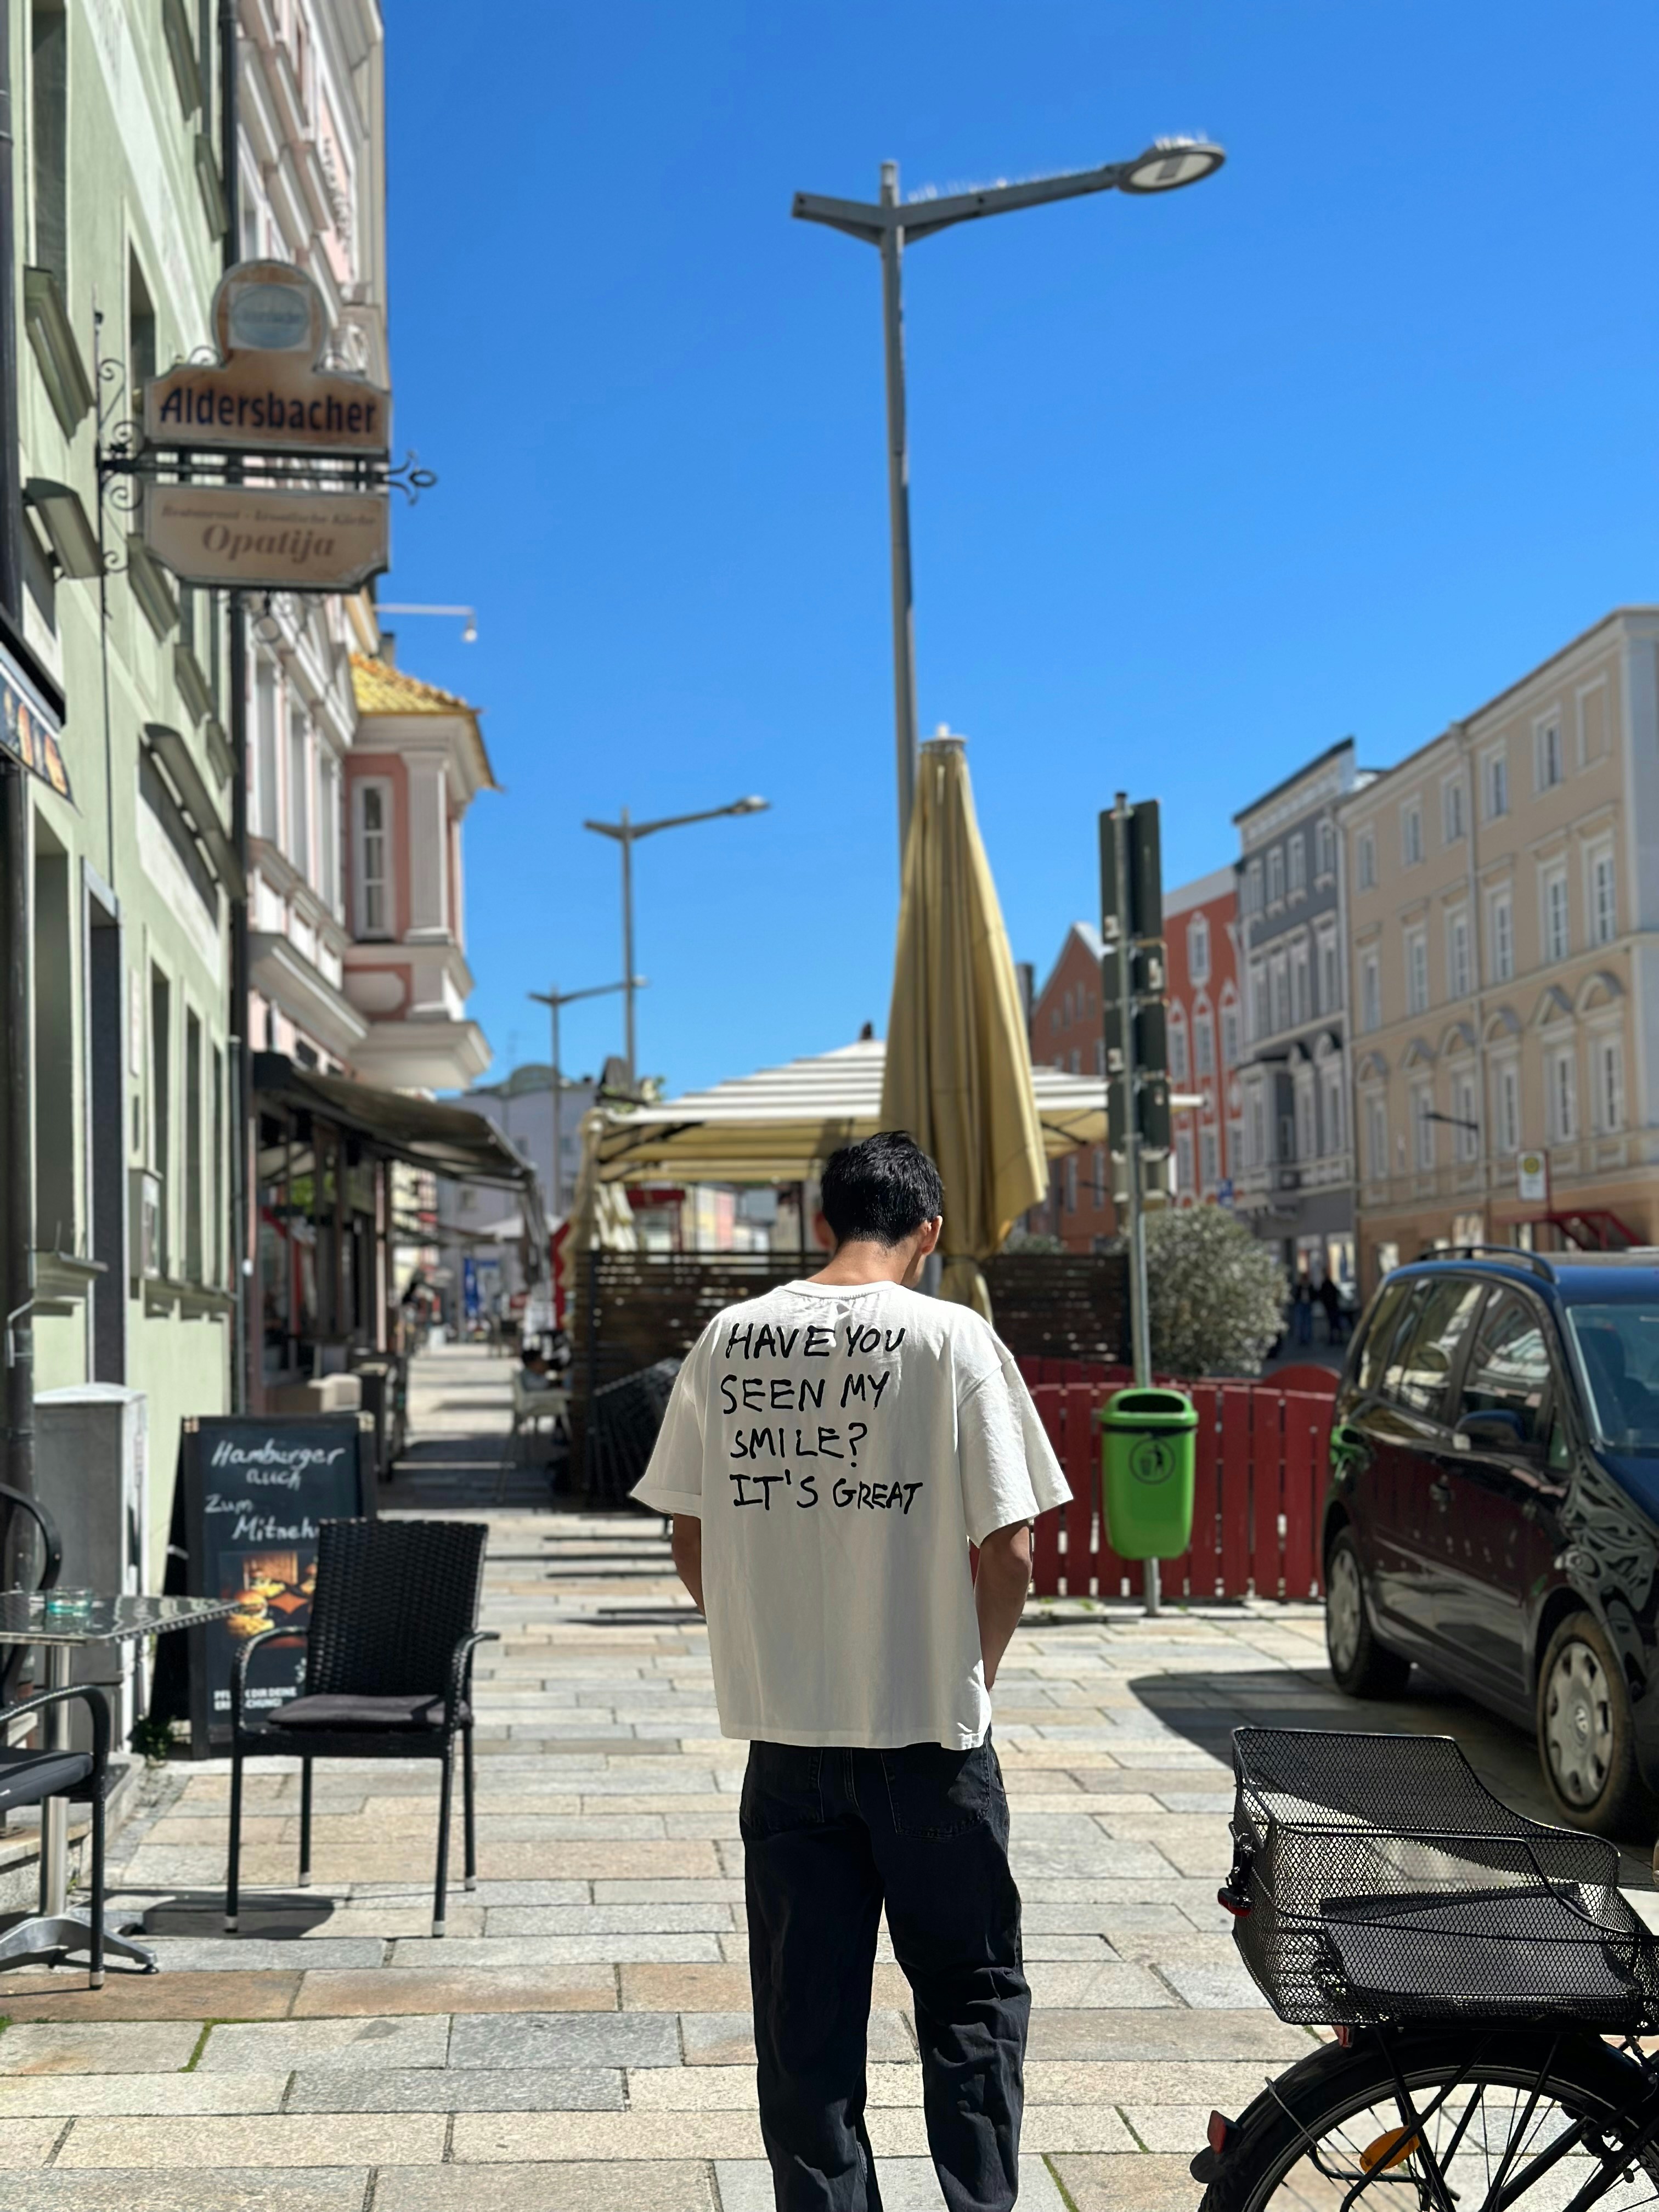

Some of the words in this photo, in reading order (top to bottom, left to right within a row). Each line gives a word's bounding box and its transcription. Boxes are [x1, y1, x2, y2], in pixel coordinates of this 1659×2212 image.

[160, 387, 376, 433] Aldersbacher
[202, 523, 335, 564] Opatija
[725, 1323, 835, 1359] HAVE
[846, 1324, 906, 1357] YOU
[720, 1374, 826, 1414] SEEN
[840, 1371, 890, 1410] MY
[211, 1438, 346, 1470] Hamburger
[730, 1423, 868, 1468] SMILE?
[246, 1468, 301, 1491] auch
[730, 1469, 819, 1511] IT'S
[832, 1478, 923, 1515] GREAT
[204, 1493, 254, 1515] Zum
[231, 1514, 320, 1542] Mitneh
